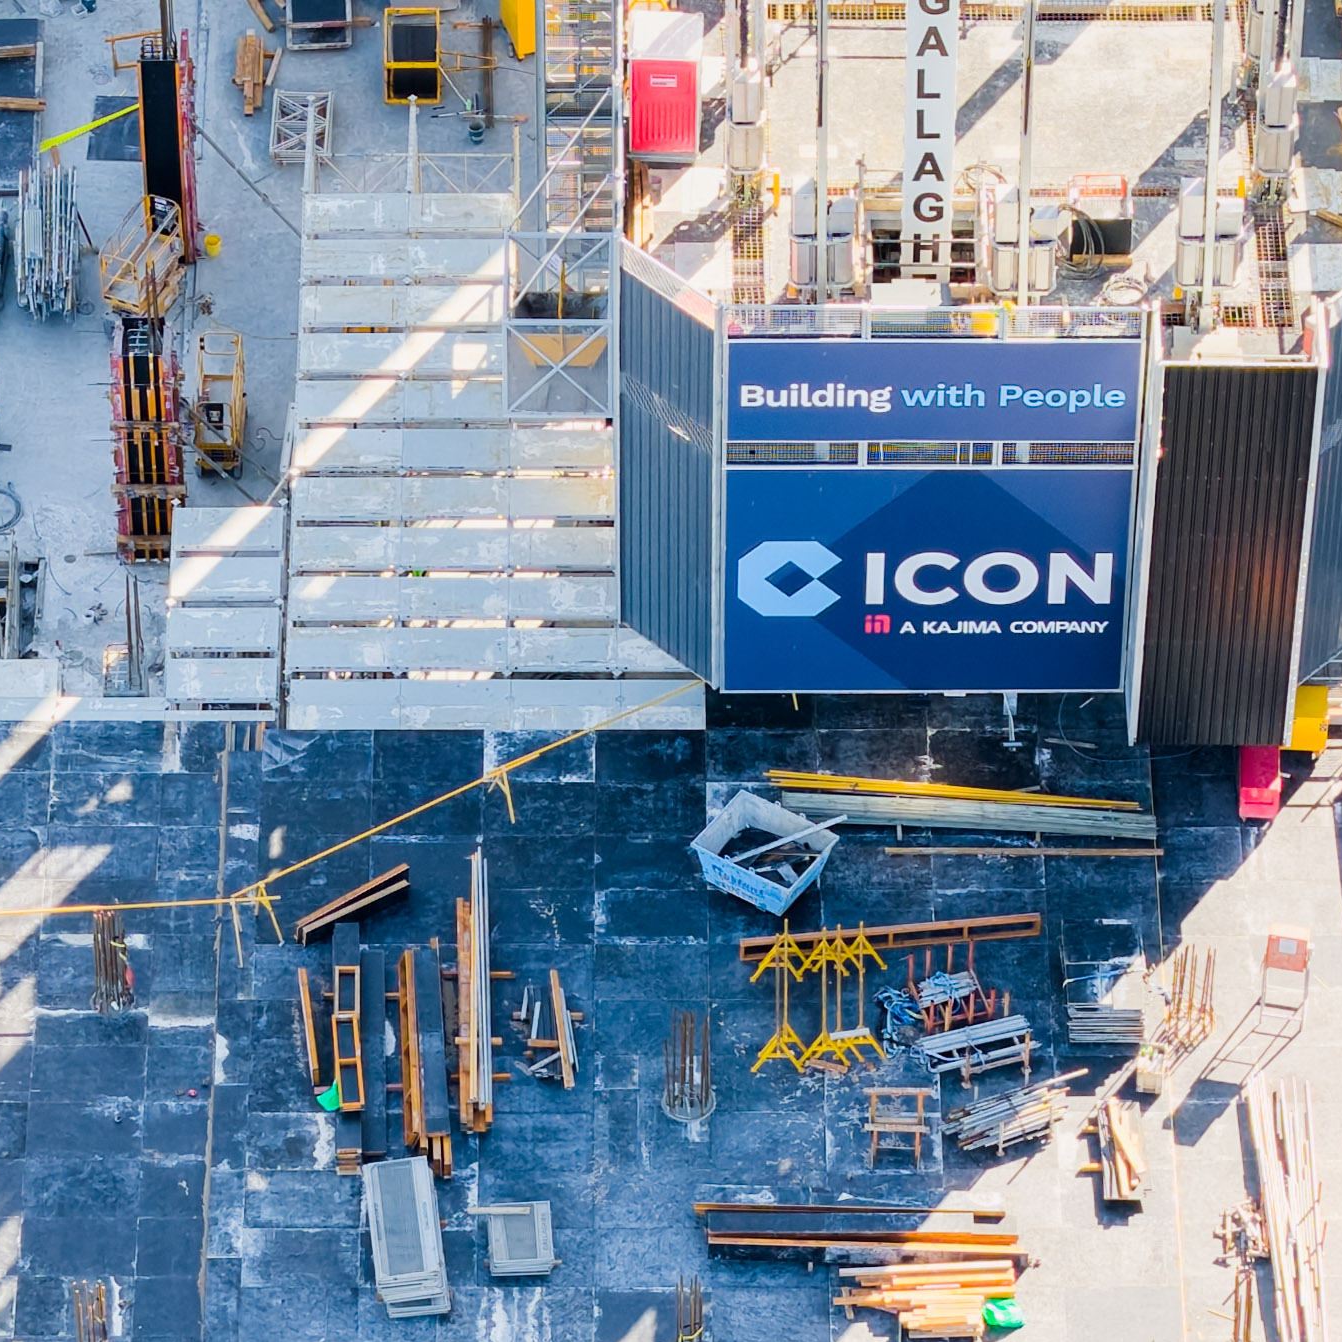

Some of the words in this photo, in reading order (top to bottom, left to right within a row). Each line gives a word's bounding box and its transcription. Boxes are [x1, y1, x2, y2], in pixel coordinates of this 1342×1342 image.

[739, 383, 893, 413] Building
[900, 383, 986, 407] with
[999, 383, 1127, 413] People
[865, 551, 1114, 606] ICON
[899, 622, 916, 635] A
[923, 620, 1001, 635] KAJIMA
[1009, 620, 1110, 635] COMPANY
